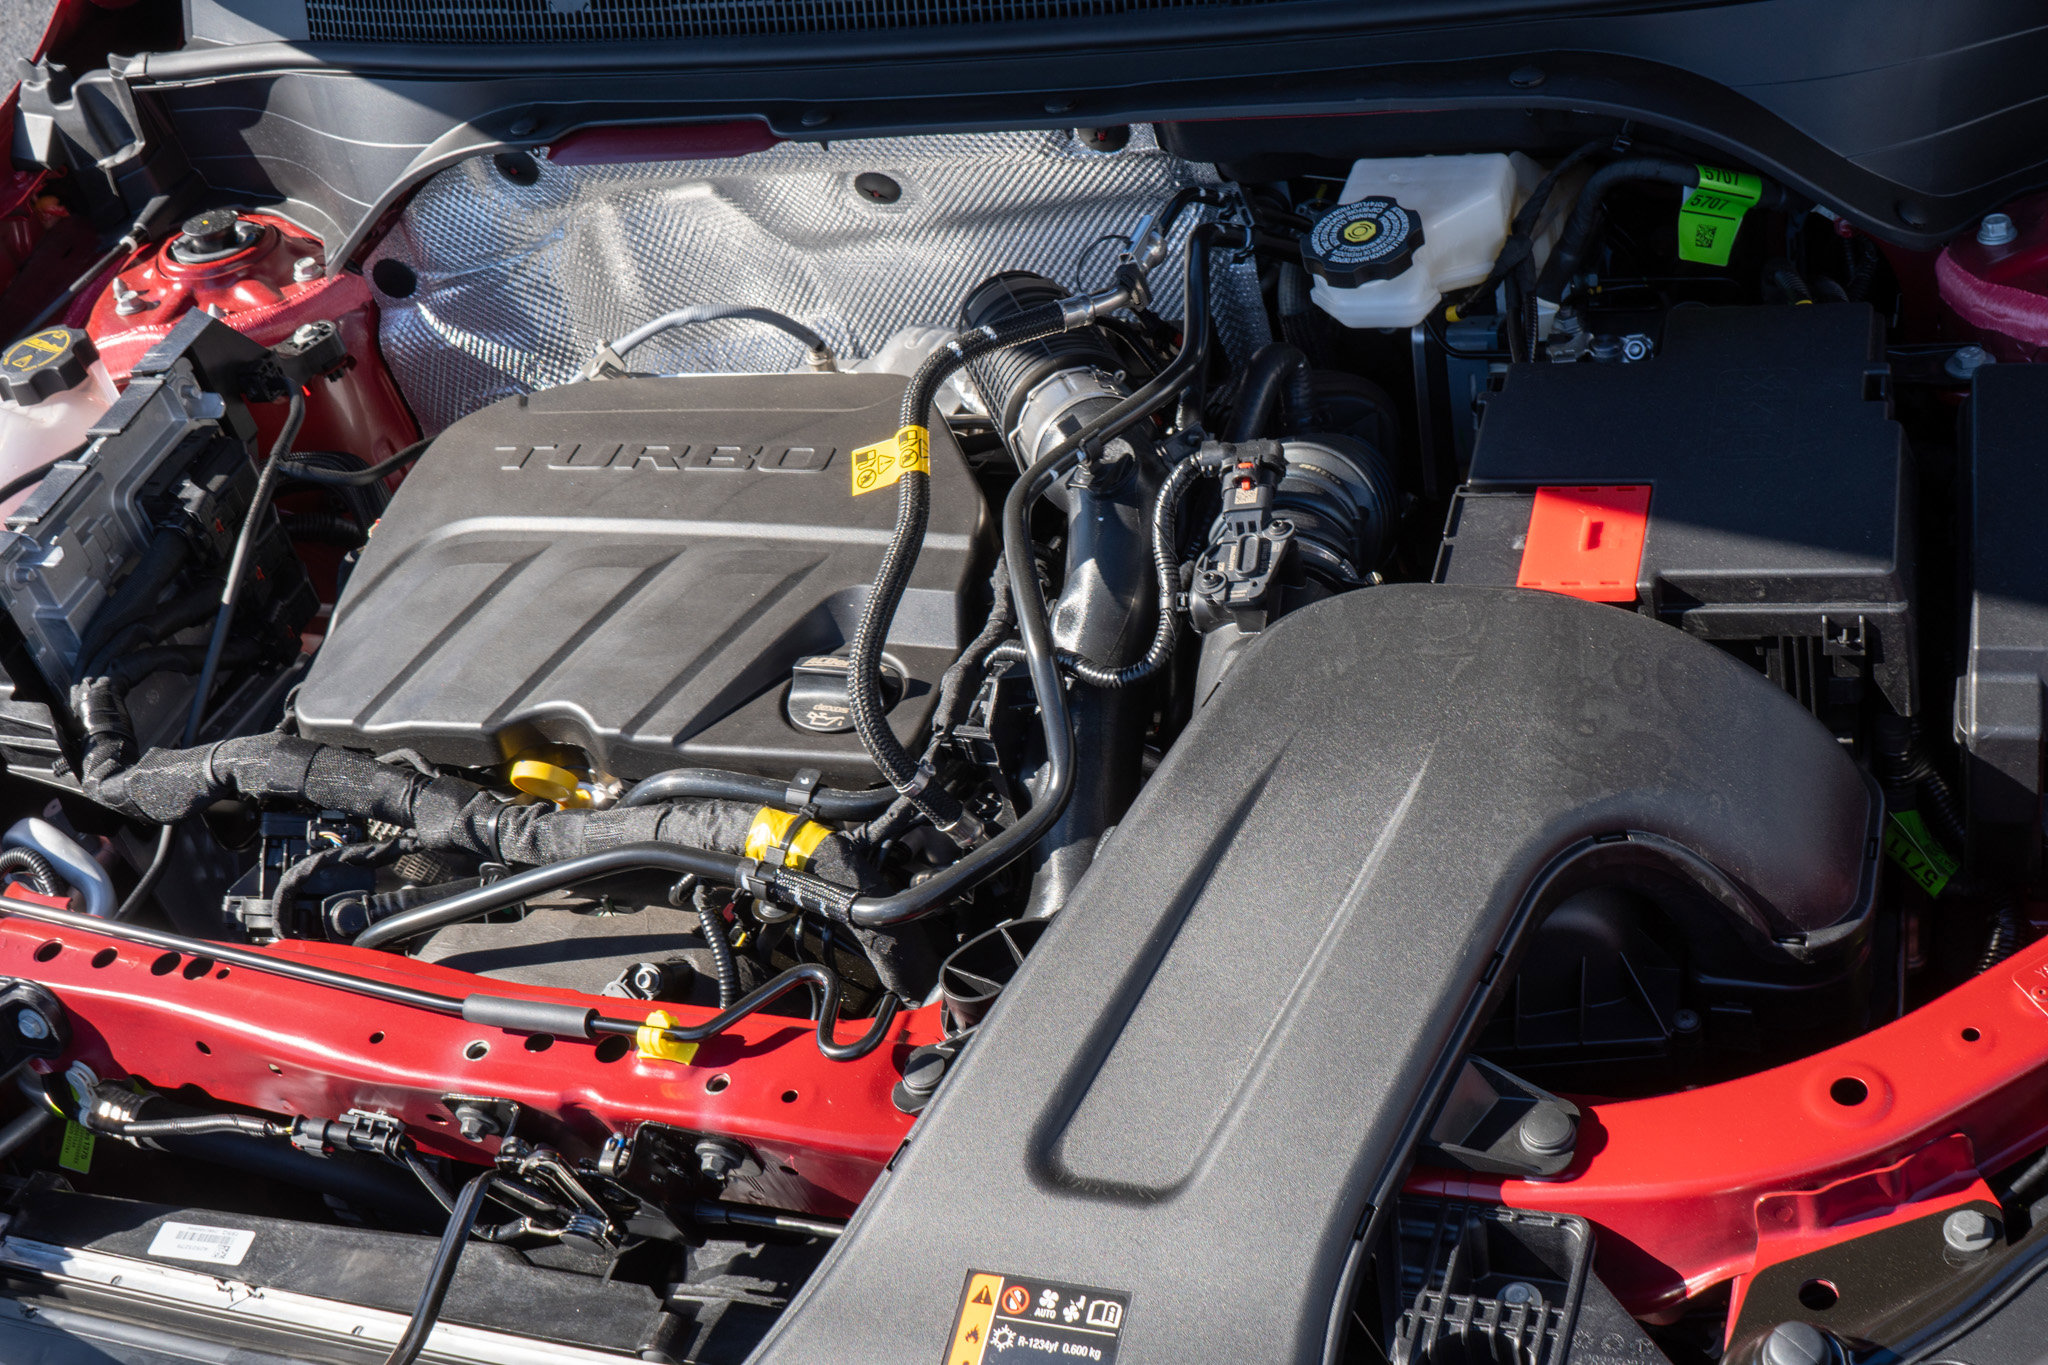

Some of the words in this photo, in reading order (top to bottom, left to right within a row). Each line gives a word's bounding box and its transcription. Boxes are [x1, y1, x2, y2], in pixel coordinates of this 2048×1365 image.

[1703, 167, 1739, 186] 5707
[1690, 194, 1729, 211] 5707
[494, 443, 837, 473] TURBO
[1889, 838, 1938, 888] 5711
[1034, 1307, 1057, 1320] AUTO
[1017, 1335, 1059, 1354] R-1234yf
[1062, 1342, 1088, 1357] 0.600
[1088, 1345, 1102, 1361] kg
